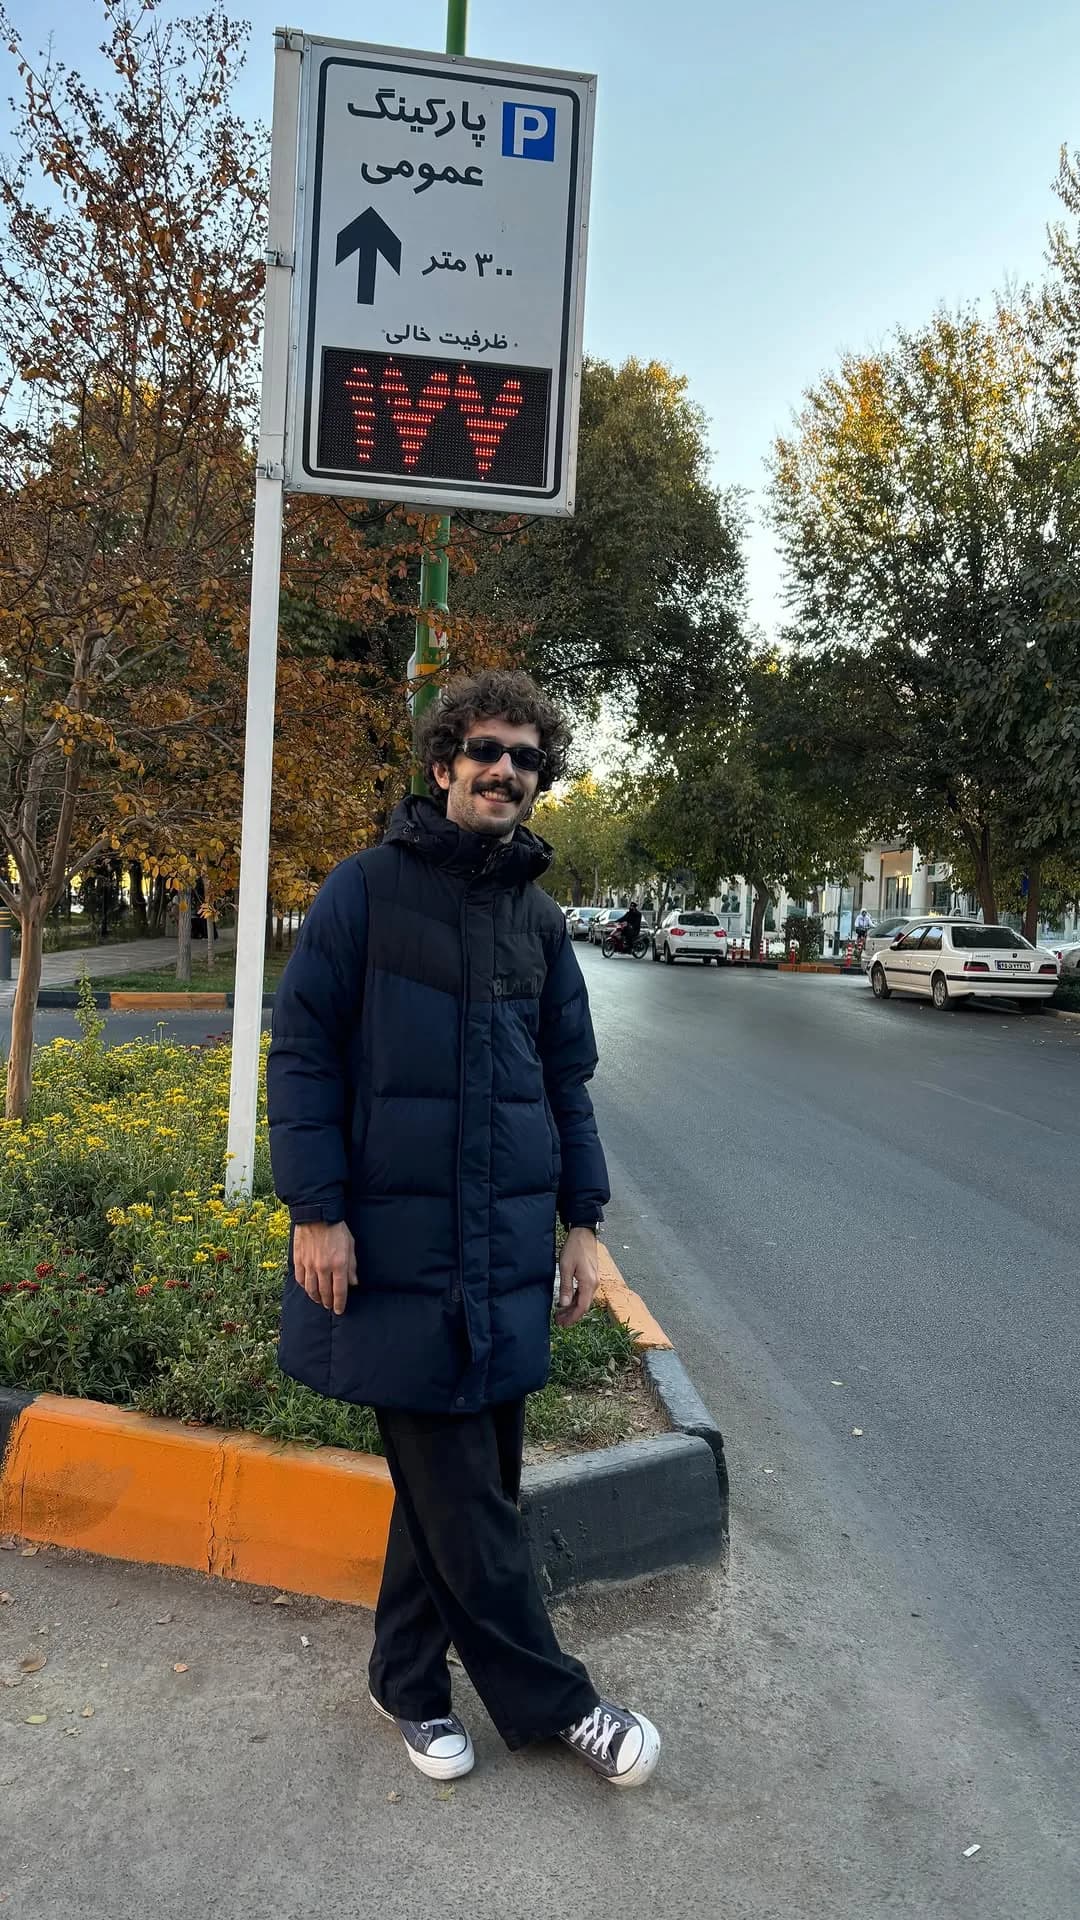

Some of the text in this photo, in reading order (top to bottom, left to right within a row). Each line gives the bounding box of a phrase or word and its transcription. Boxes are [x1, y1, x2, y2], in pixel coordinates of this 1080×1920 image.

[348, 88, 486, 147] پارکینگ
[513, 106, 549, 156] P
[361, 160, 484, 194] عمومی
[421, 251, 467, 276] متر
[385, 324, 508, 353] ظرفیت خالی
